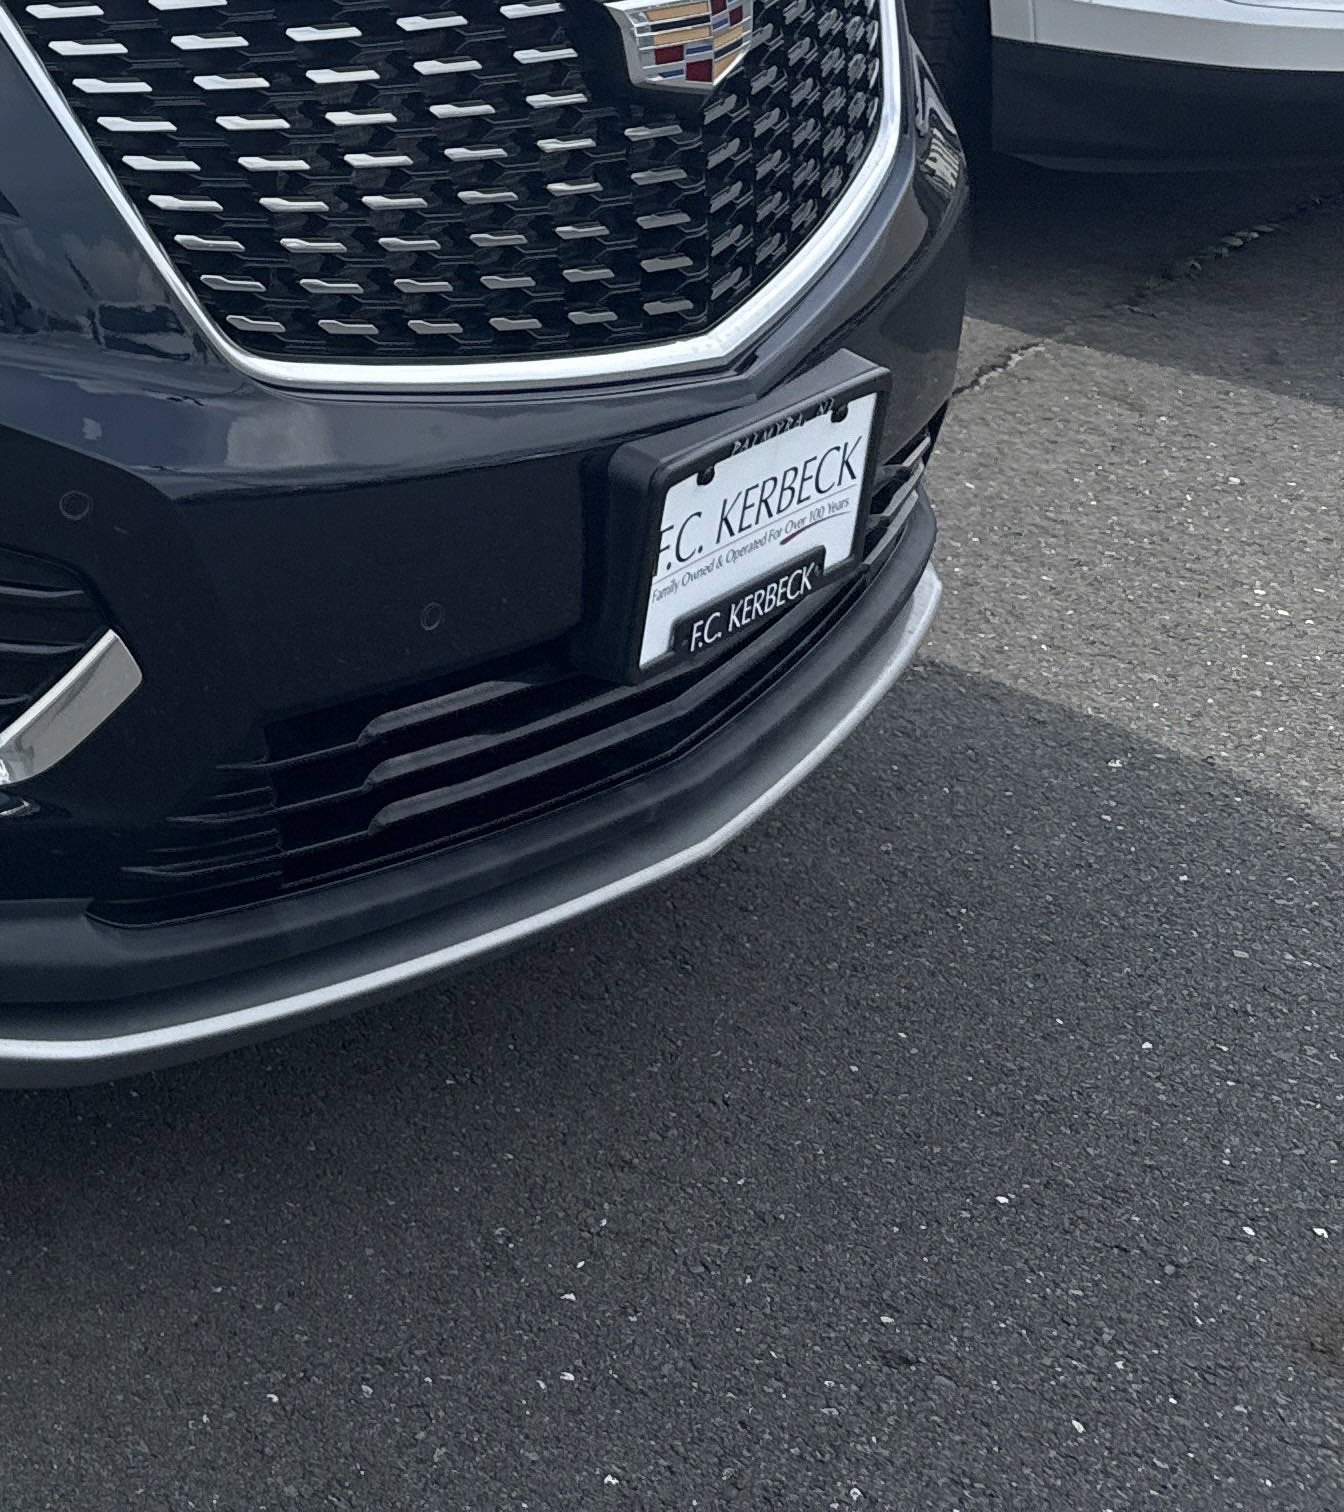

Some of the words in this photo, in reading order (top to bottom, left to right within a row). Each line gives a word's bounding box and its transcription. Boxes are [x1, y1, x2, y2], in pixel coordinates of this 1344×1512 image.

[715, 435, 863, 545] KERBECK
[651, 578, 680, 604] Family
[681, 558, 715, 586] Owned
[725, 530, 768, 564] Operated
[785, 516, 806, 535] Over
[808, 506, 826, 523] 100
[827, 498, 850, 515] Years
[689, 611, 723, 652] F.C.
[728, 561, 817, 633] KERBECK
